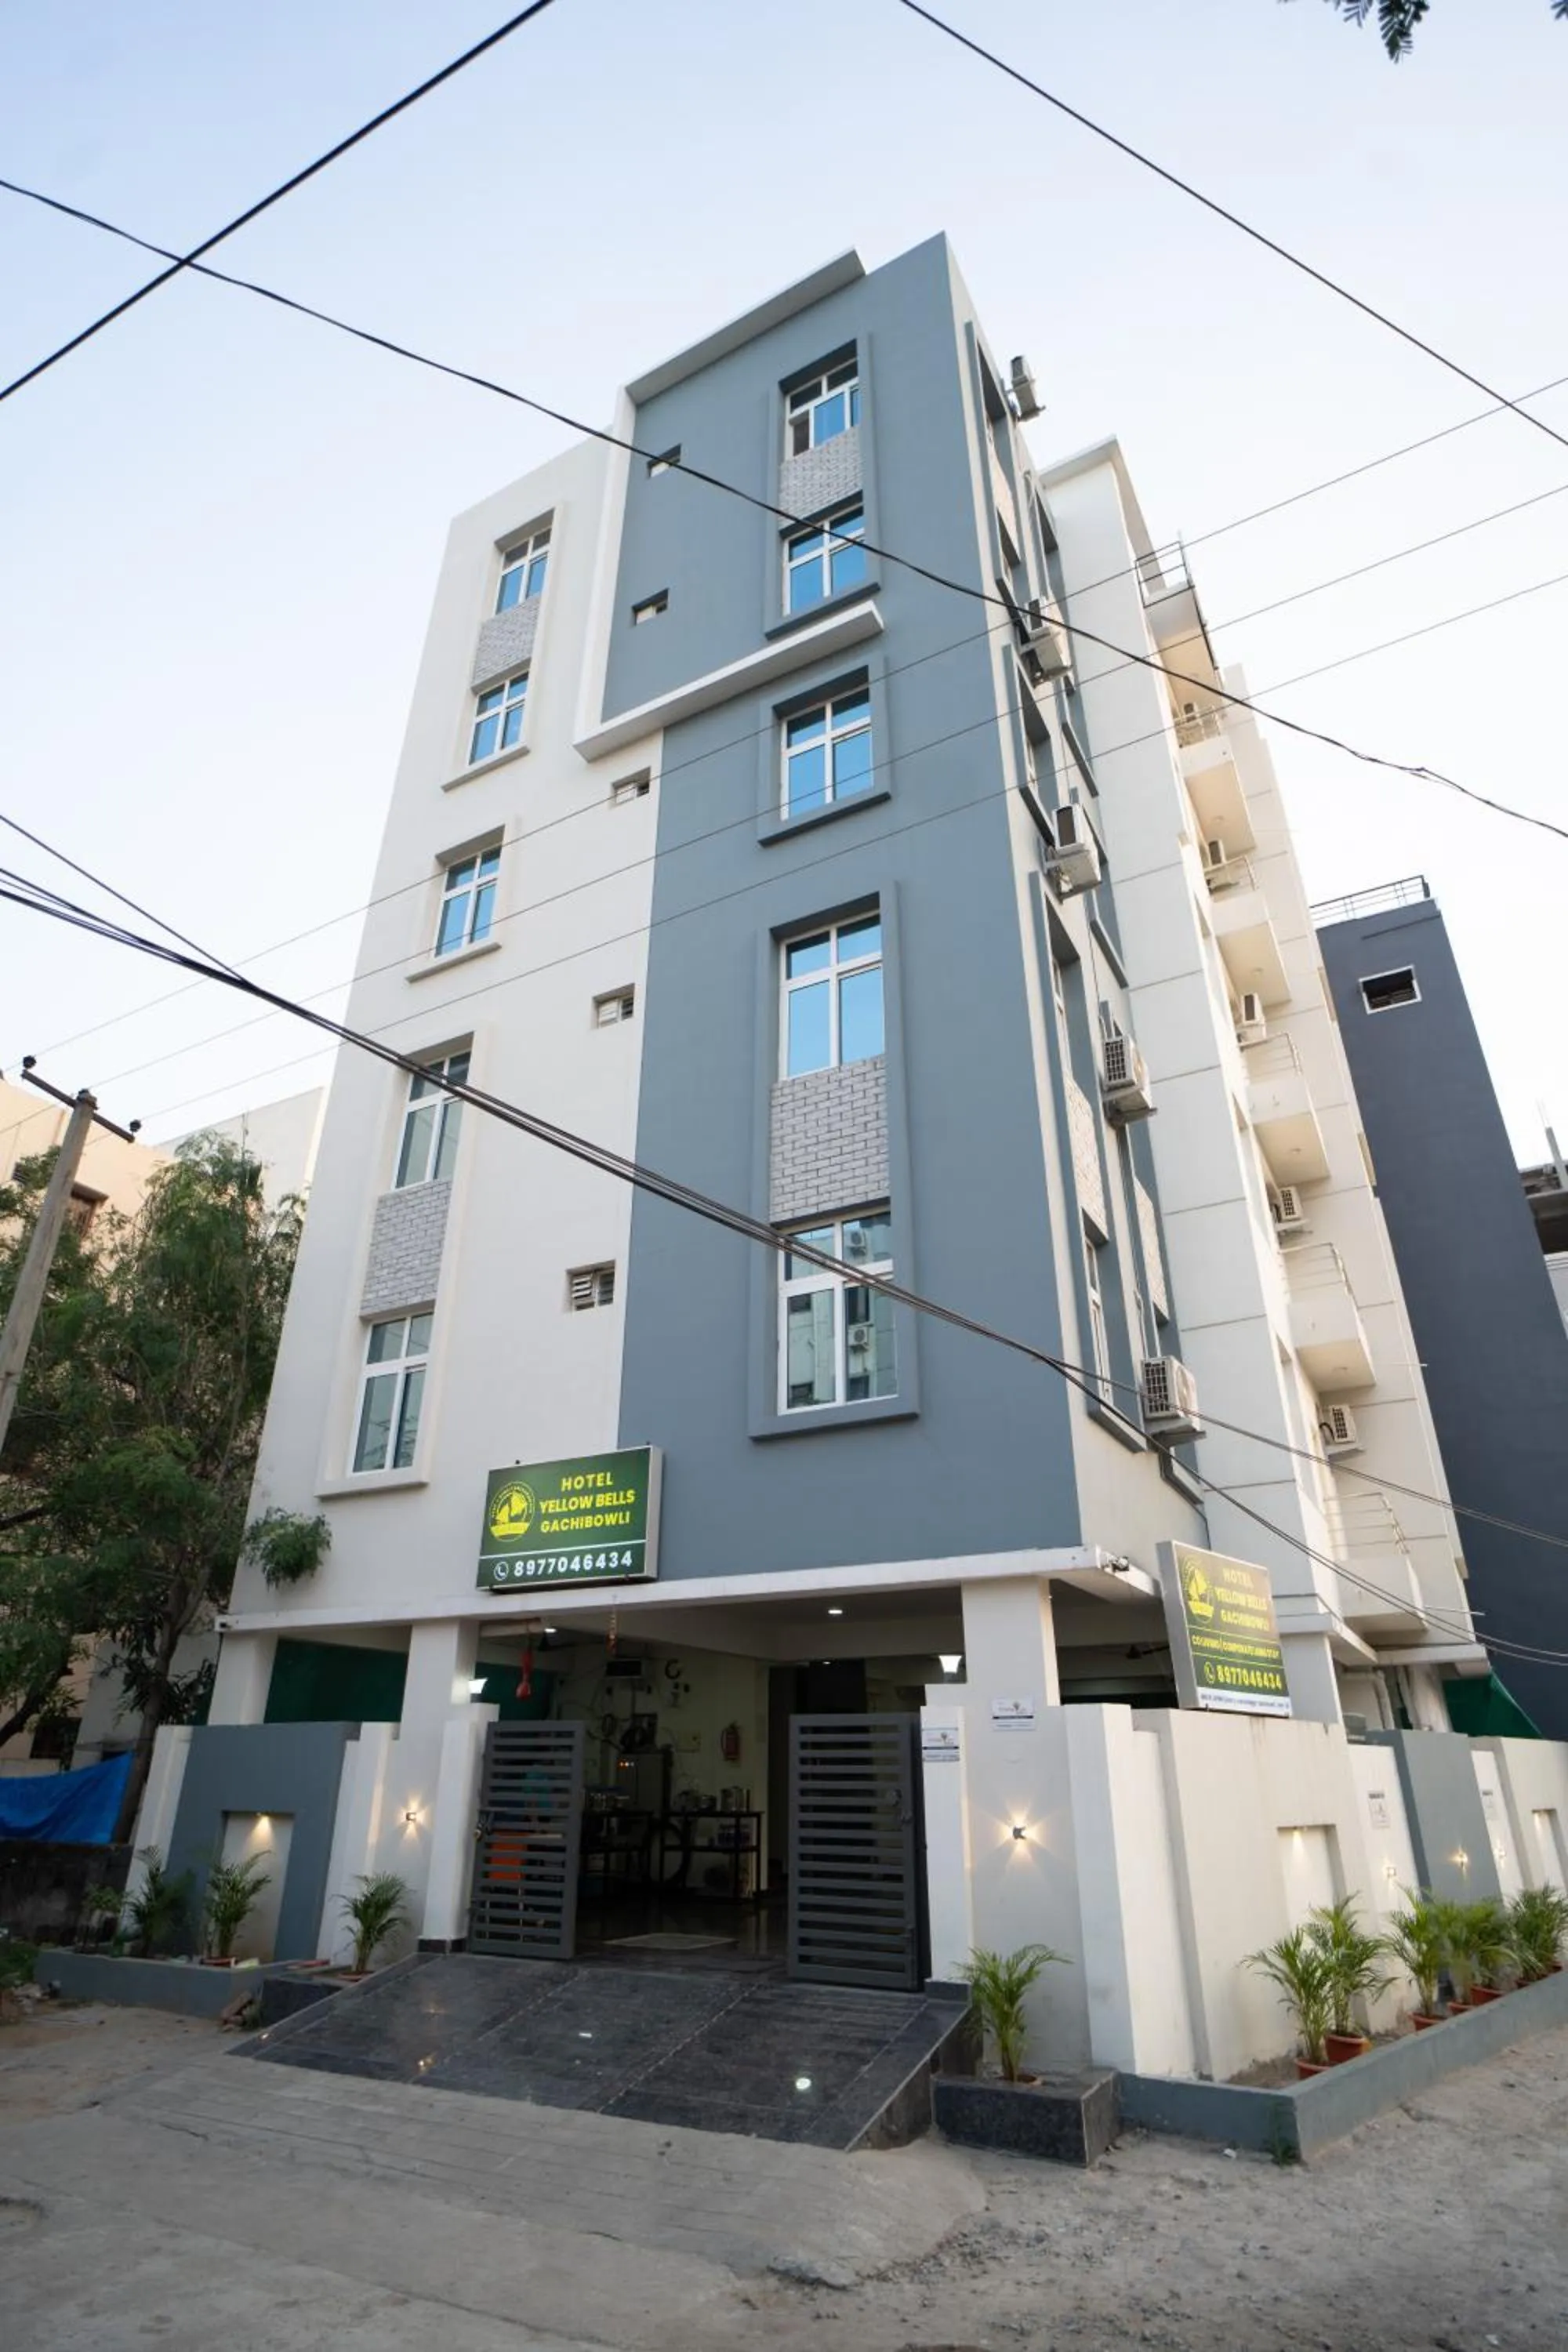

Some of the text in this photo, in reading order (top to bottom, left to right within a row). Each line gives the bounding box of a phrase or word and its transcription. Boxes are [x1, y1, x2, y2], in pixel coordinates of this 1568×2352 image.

[561, 1472, 613, 1491] HOTEL
[539, 1496, 592, 1514] YELLOW
[595, 1490, 635, 1507] BELLS
[540, 1512, 630, 1533] GACHIBOWLI
[514, 1551, 632, 1577] 8977046434
[1222, 1568, 1254, 1588] HOTEL
[1216, 1664, 1283, 1690] 8977046434
